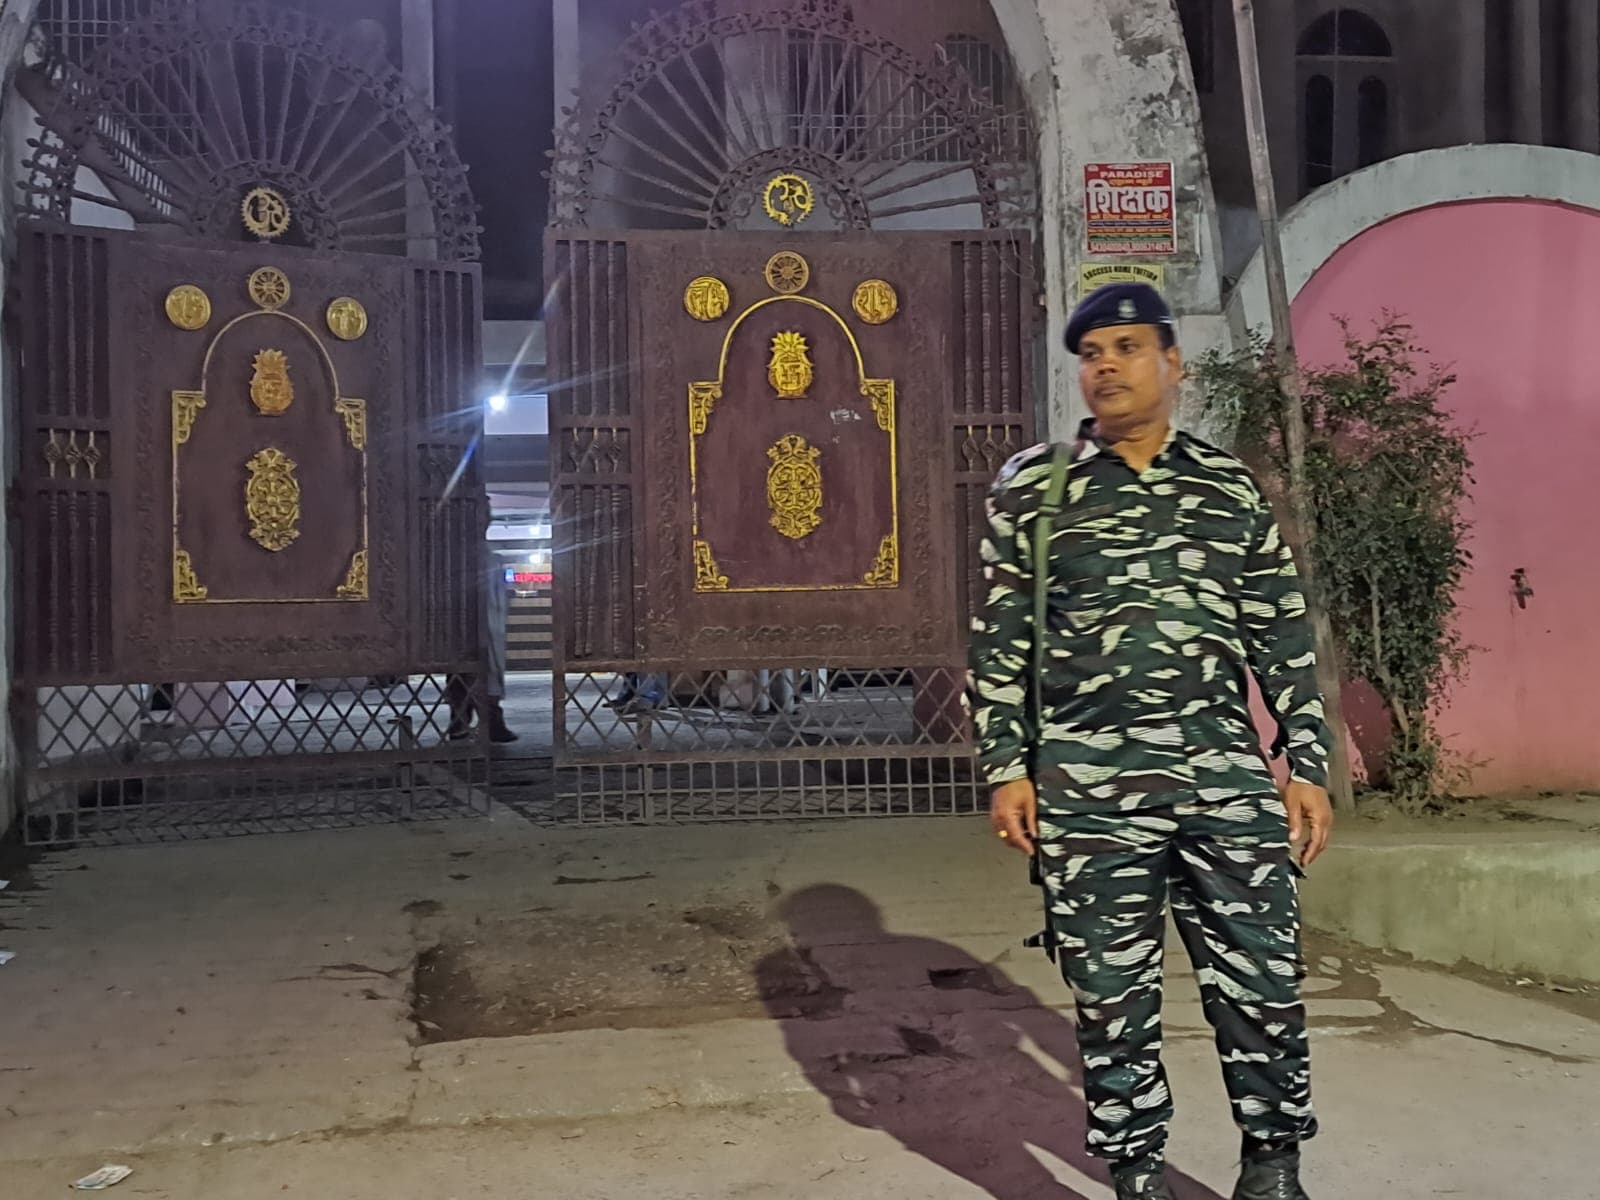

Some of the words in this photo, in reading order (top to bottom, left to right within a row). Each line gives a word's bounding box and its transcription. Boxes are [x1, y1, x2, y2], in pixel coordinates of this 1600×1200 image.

[1099, 170, 1164, 178] PARADISE
[1086, 179, 1171, 213] शिक्षक
[1083, 266, 1112, 280] SUCCESS
[1113, 265, 1132, 273] HOME
